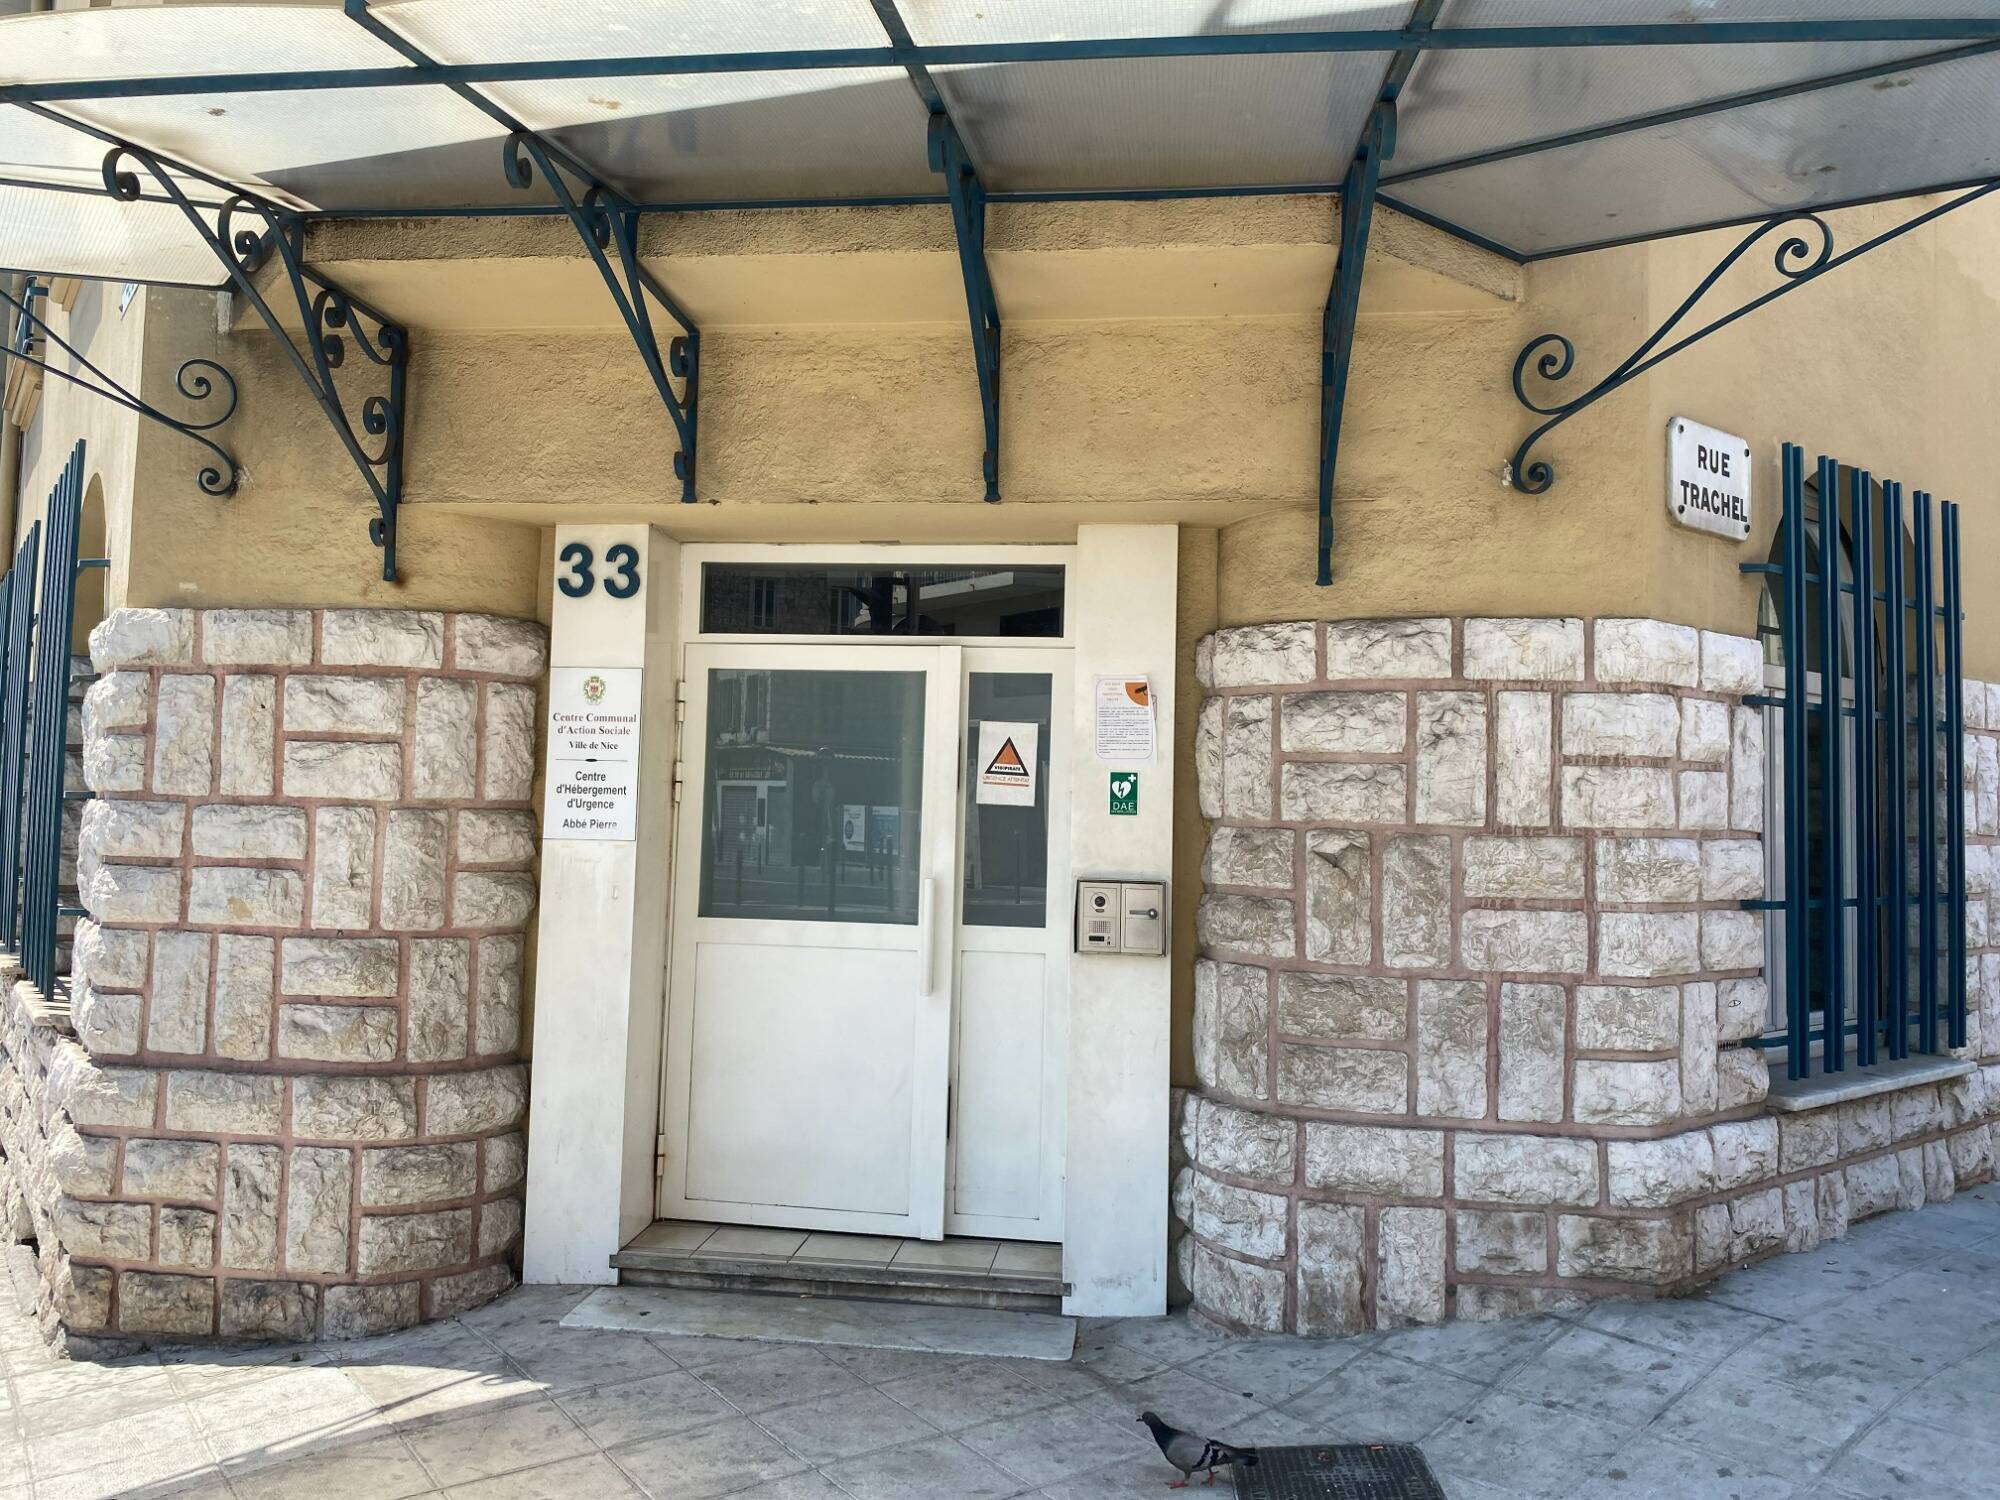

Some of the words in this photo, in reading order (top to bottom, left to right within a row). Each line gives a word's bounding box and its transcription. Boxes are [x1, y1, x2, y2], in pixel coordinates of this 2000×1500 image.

[1697, 444, 1730, 478] RUE
[1680, 479, 1748, 523] TRACHEL
[557, 543, 641, 599] 33
[552, 712, 584, 722] Centre
[586, 713, 637, 723] Communal
[557, 725, 596, 734] d'Action
[598, 726, 631, 735] Sociale
[569, 741, 588, 749] Ville
[589, 741, 599, 750] de
[600, 741, 619, 750] Nice
[575, 770, 606, 781] Centre
[556, 783, 627, 797] d'Hébergement
[567, 798, 615, 811] d'Urgence
[1112, 801, 1135, 811] DAE
[562, 818, 587, 829] Abbé
[589, 819, 617, 829] Pierre
